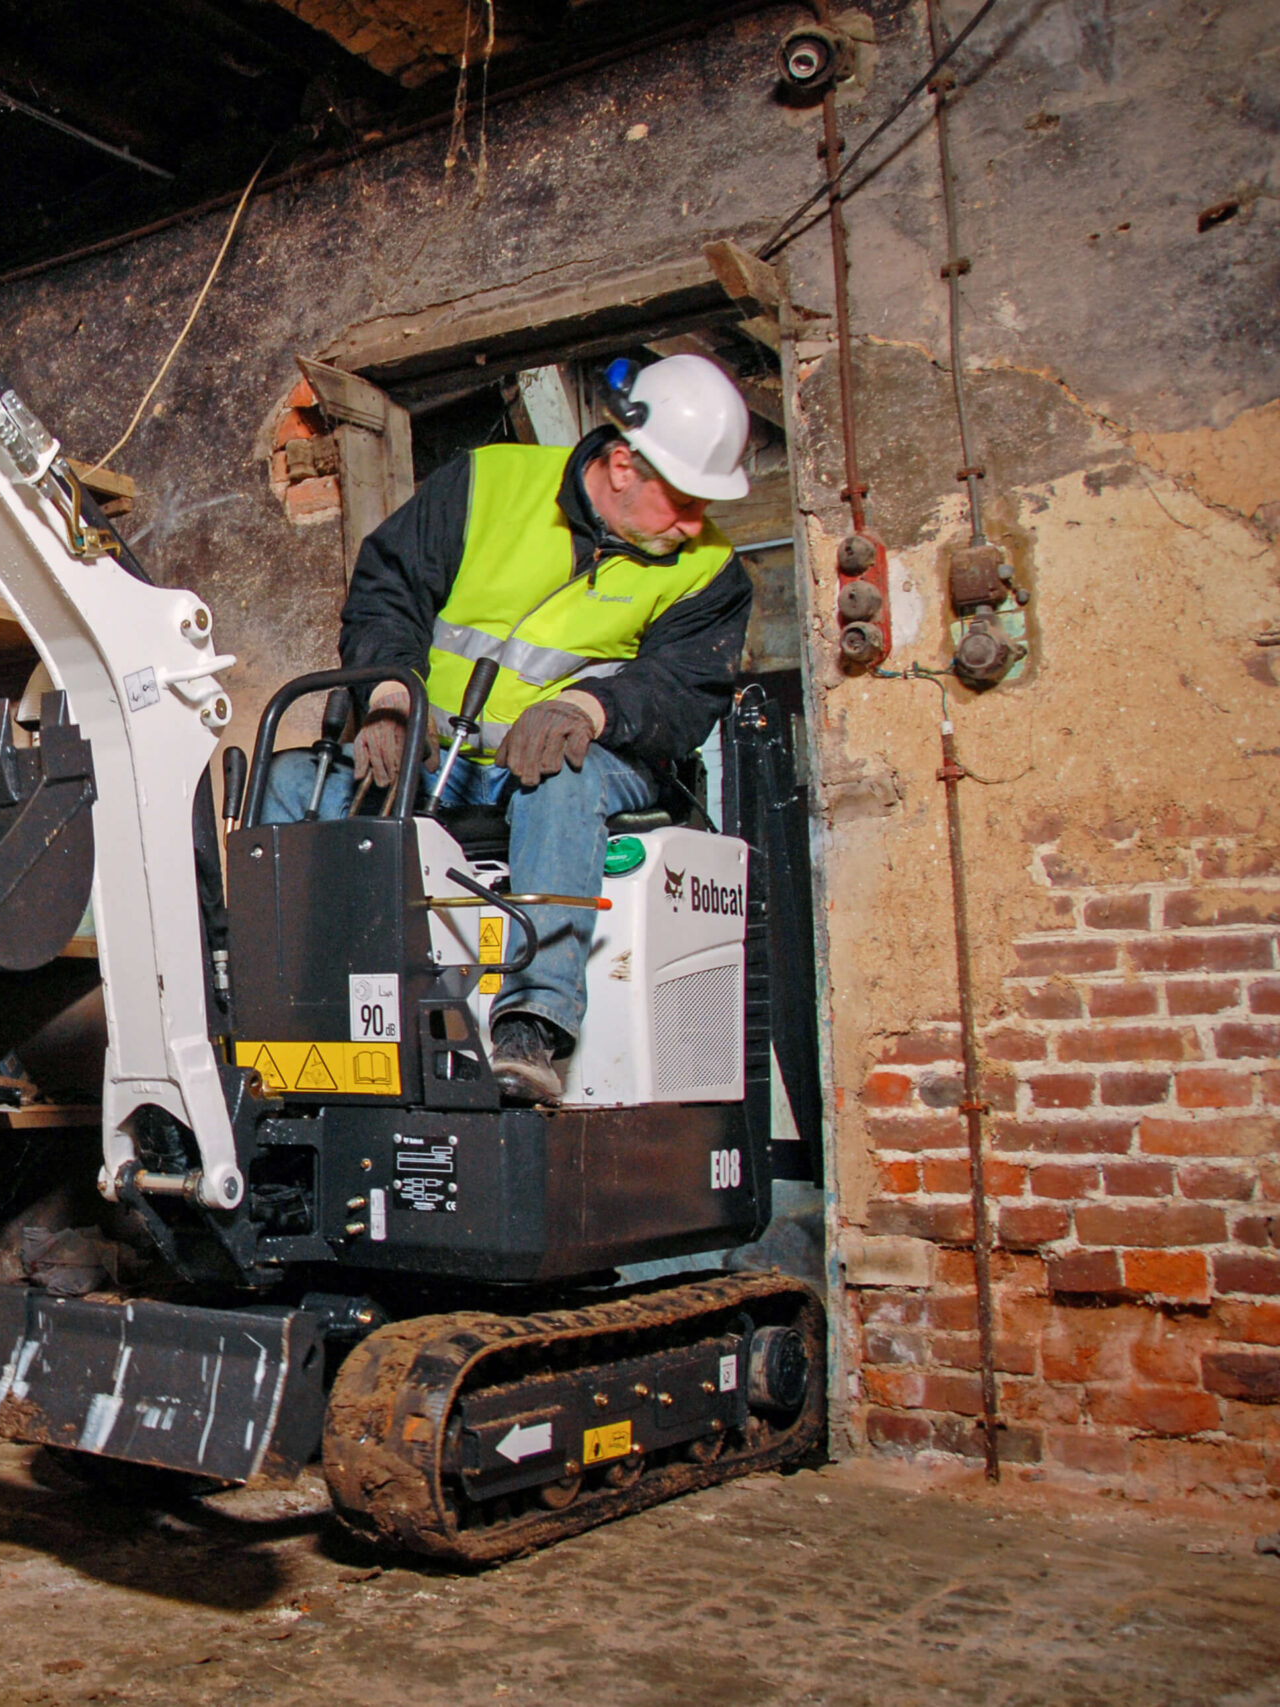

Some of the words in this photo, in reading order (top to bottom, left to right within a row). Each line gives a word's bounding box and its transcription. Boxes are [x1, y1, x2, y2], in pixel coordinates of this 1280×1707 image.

[691, 876, 744, 917] Bobcat
[361, 1004, 384, 1036] 90
[385, 1022, 396, 1036] dB
[710, 1148, 741, 1189] E08
